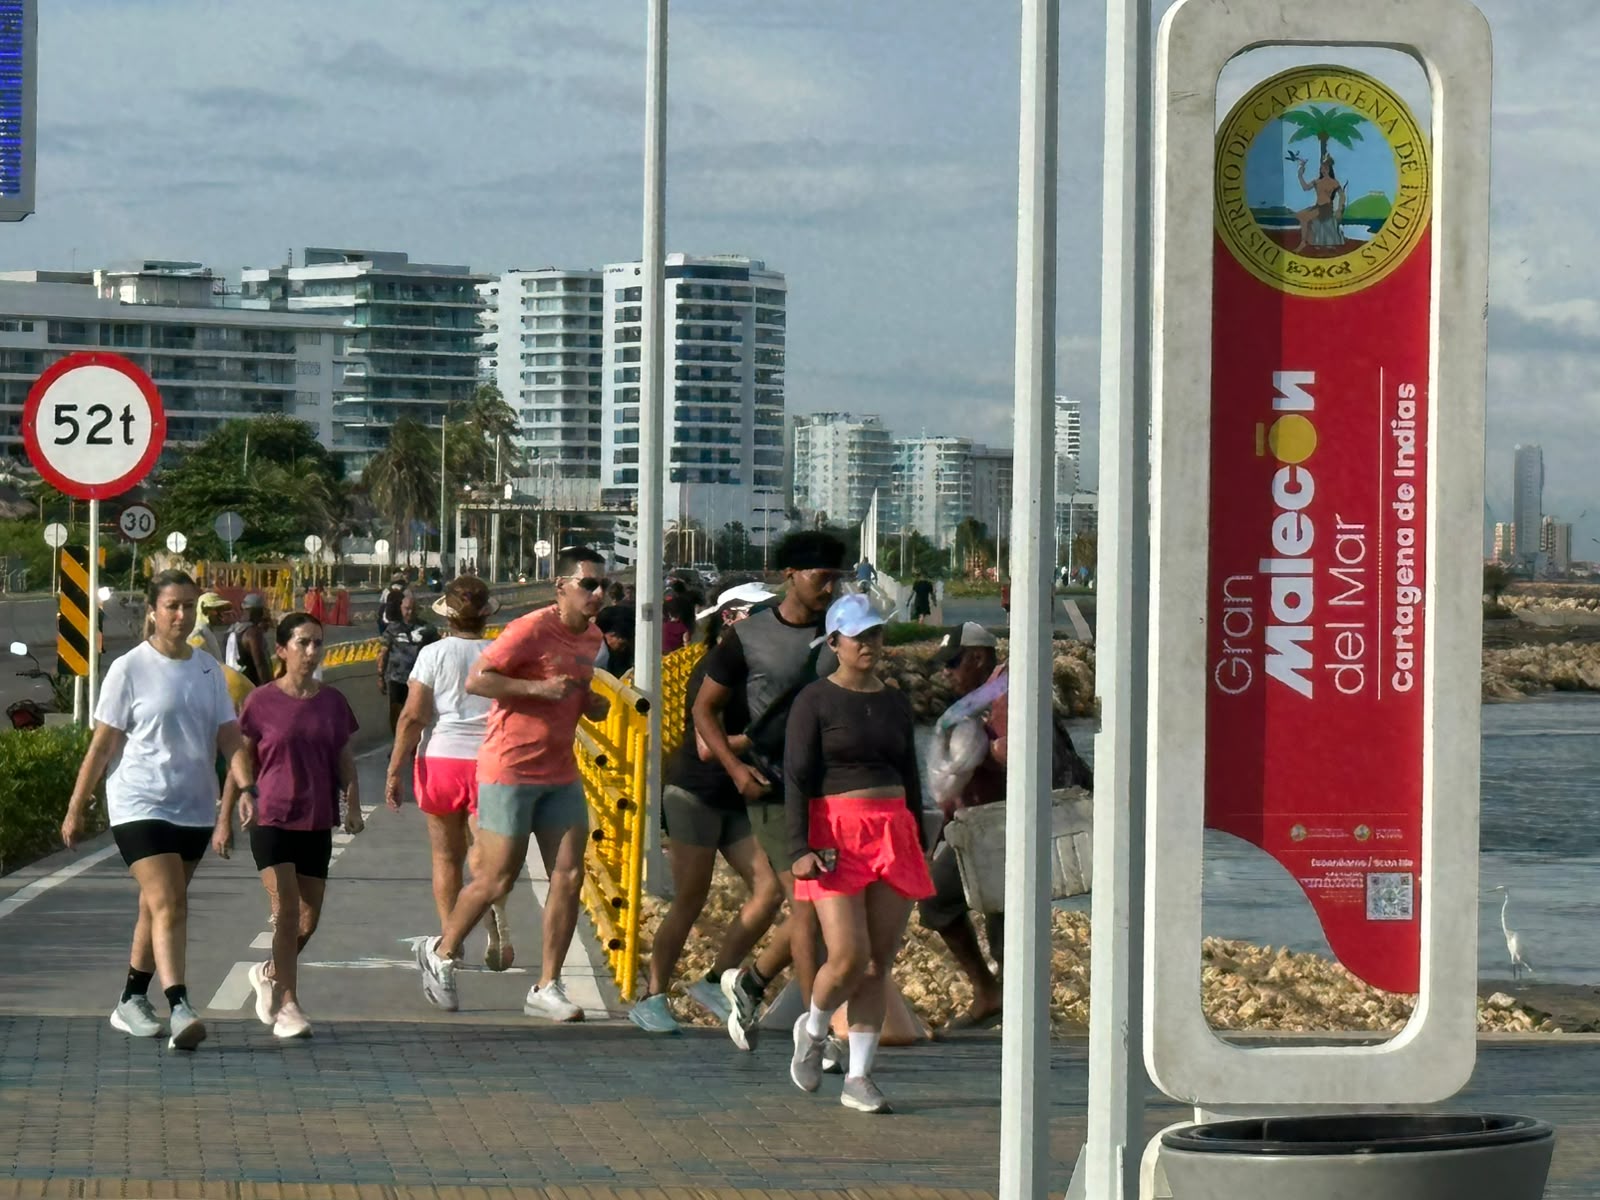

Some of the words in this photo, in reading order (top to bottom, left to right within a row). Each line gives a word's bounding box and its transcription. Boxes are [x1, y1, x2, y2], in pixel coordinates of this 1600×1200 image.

[1233, 126, 1256, 159] DE
[1251, 79, 1401, 135] CARTAGENA
[1393, 139, 1418, 175] DE
[1220, 164, 1282, 266] DISTRITO
[1360, 182, 1421, 266] INDIAS
[55, 403, 136, 446] 52t
[1390, 382, 1417, 477] Indias
[124, 512, 151, 532] 30
[1254, 370, 1318, 700] Malecón
[1392, 482, 1416, 522] de
[1328, 513, 1366, 606] Mar
[1214, 575, 1254, 695] Gran
[1391, 528, 1422, 693] Cartagena
[1325, 622, 1366, 695] del
